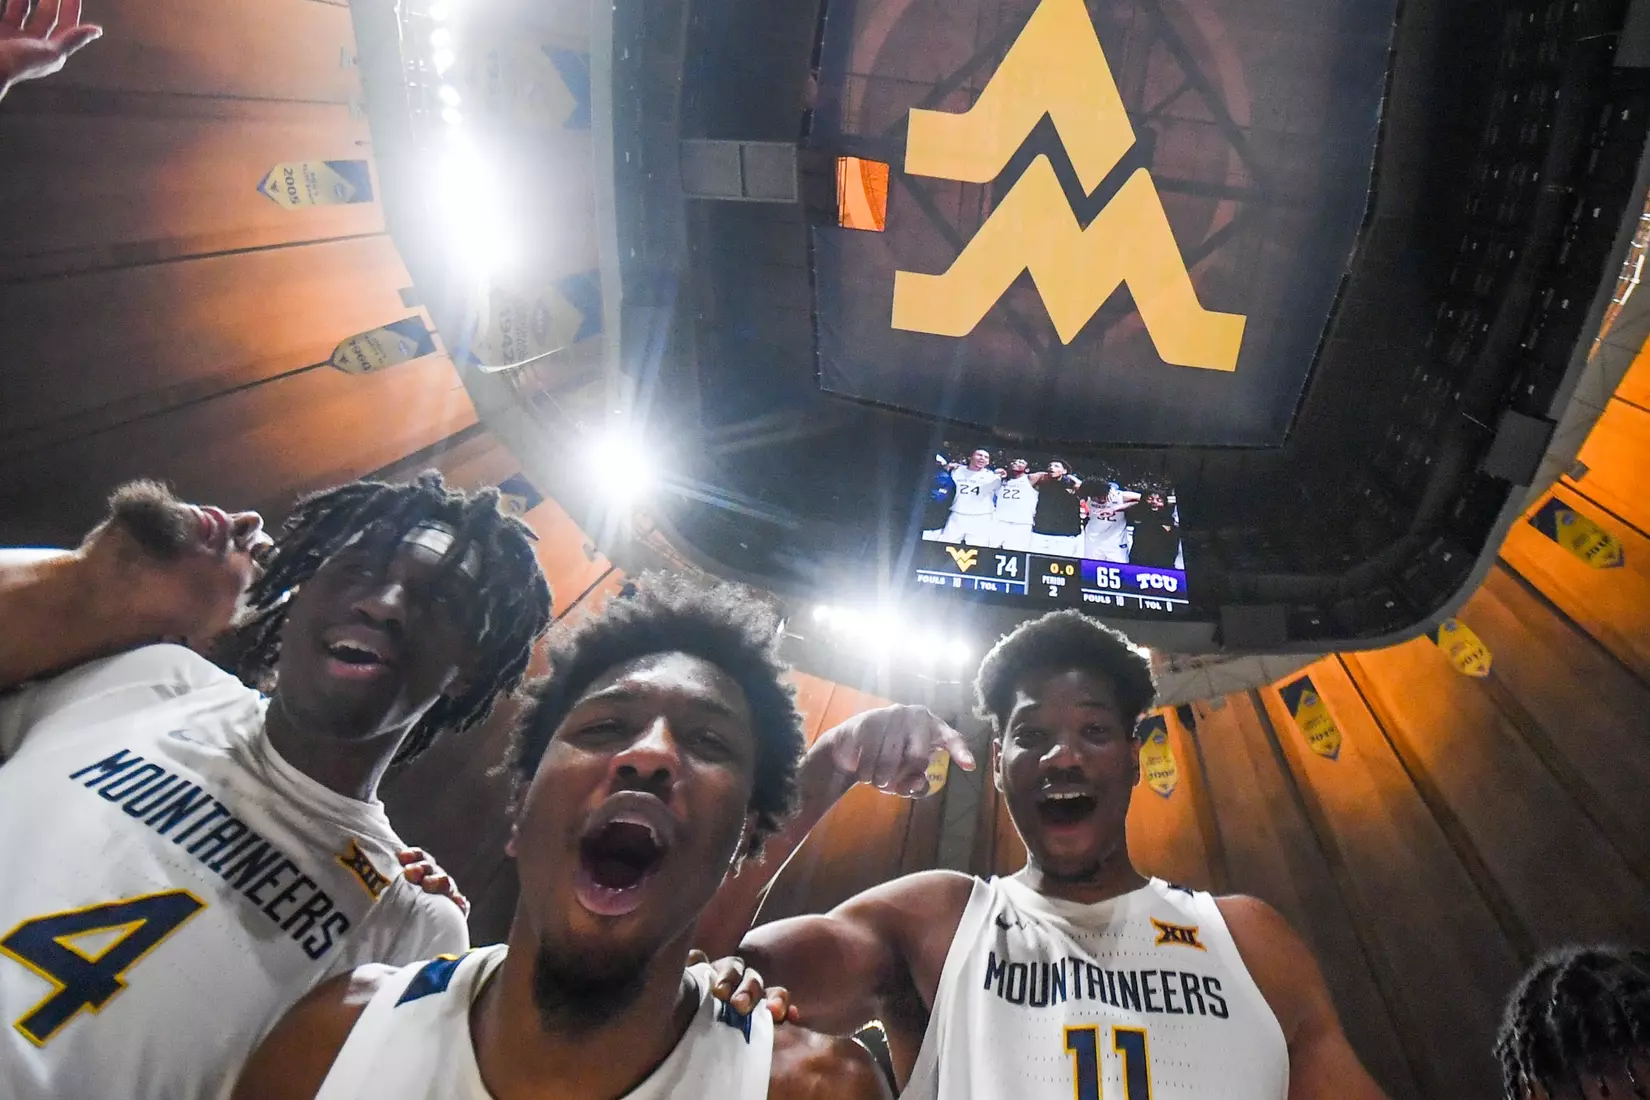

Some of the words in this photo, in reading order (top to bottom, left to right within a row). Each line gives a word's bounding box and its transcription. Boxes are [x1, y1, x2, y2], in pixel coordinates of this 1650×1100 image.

[959, 483, 981, 497] 24
[1002, 487, 1021, 501] 22
[994, 554, 1018, 578] 74
[1050, 562, 1075, 576] 0.0
[917, 575, 946, 586] FOULS
[1042, 575, 1066, 586] PERIOD
[1096, 566, 1121, 590] 65
[1136, 573, 1179, 593] TCU
[980, 581, 997, 592] TOL
[1049, 586, 1058, 598] 2
[1083, 593, 1111, 605] FOULS
[1145, 600, 1162, 611] TOL
[69, 748, 351, 960] MOUNTAINEERS
[1149, 917, 1208, 952] XII
[0, 888, 207, 1047] 4
[984, 951, 1230, 1020] MOUNTAINEERS
[1063, 1023, 1153, 1100] 11
